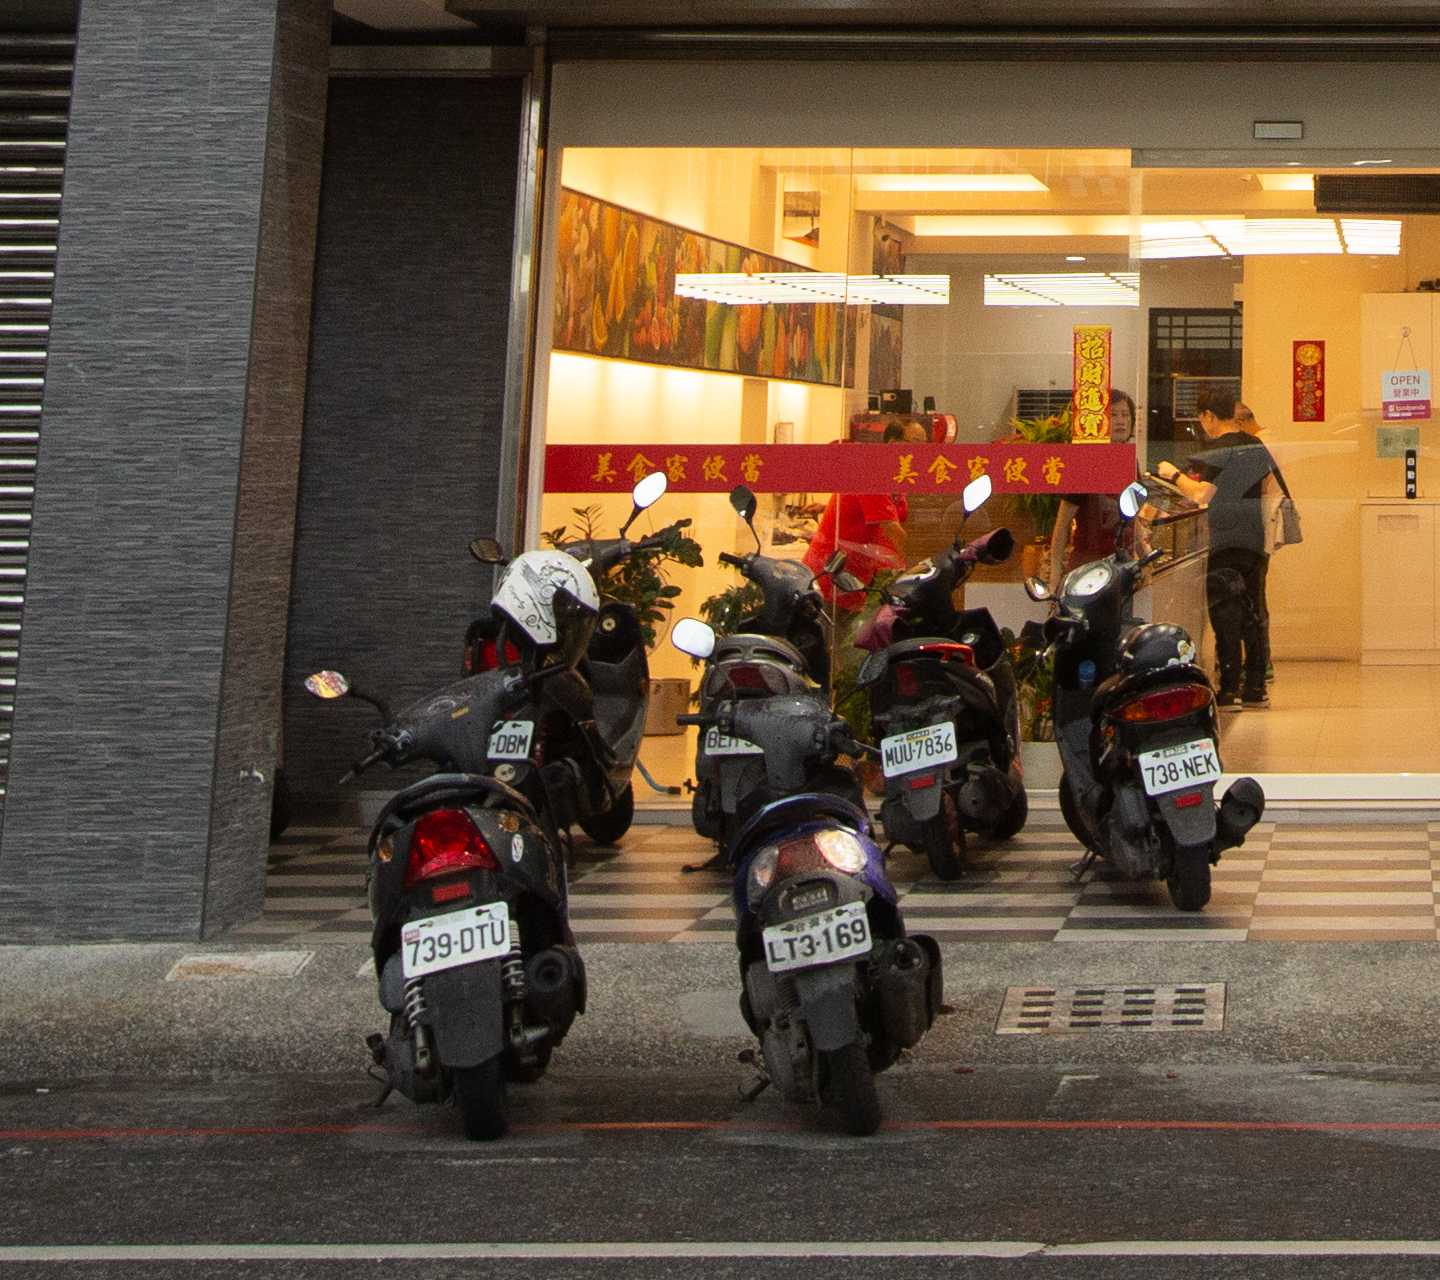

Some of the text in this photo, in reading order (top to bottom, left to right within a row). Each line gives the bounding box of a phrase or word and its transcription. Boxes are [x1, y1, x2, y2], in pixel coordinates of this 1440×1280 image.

[1080, 336, 1106, 438] 招財進寶
[1390, 375, 1421, 386] OPEN
[592, 452, 765, 484] 美食家便當
[492, 733, 529, 754] -DBM
[885, 733, 953, 767] MUU-7836
[1145, 753, 1217, 787] 738-NEK
[406, 920, 506, 967] 739-DTU
[768, 918, 867, 962] LT3-169
